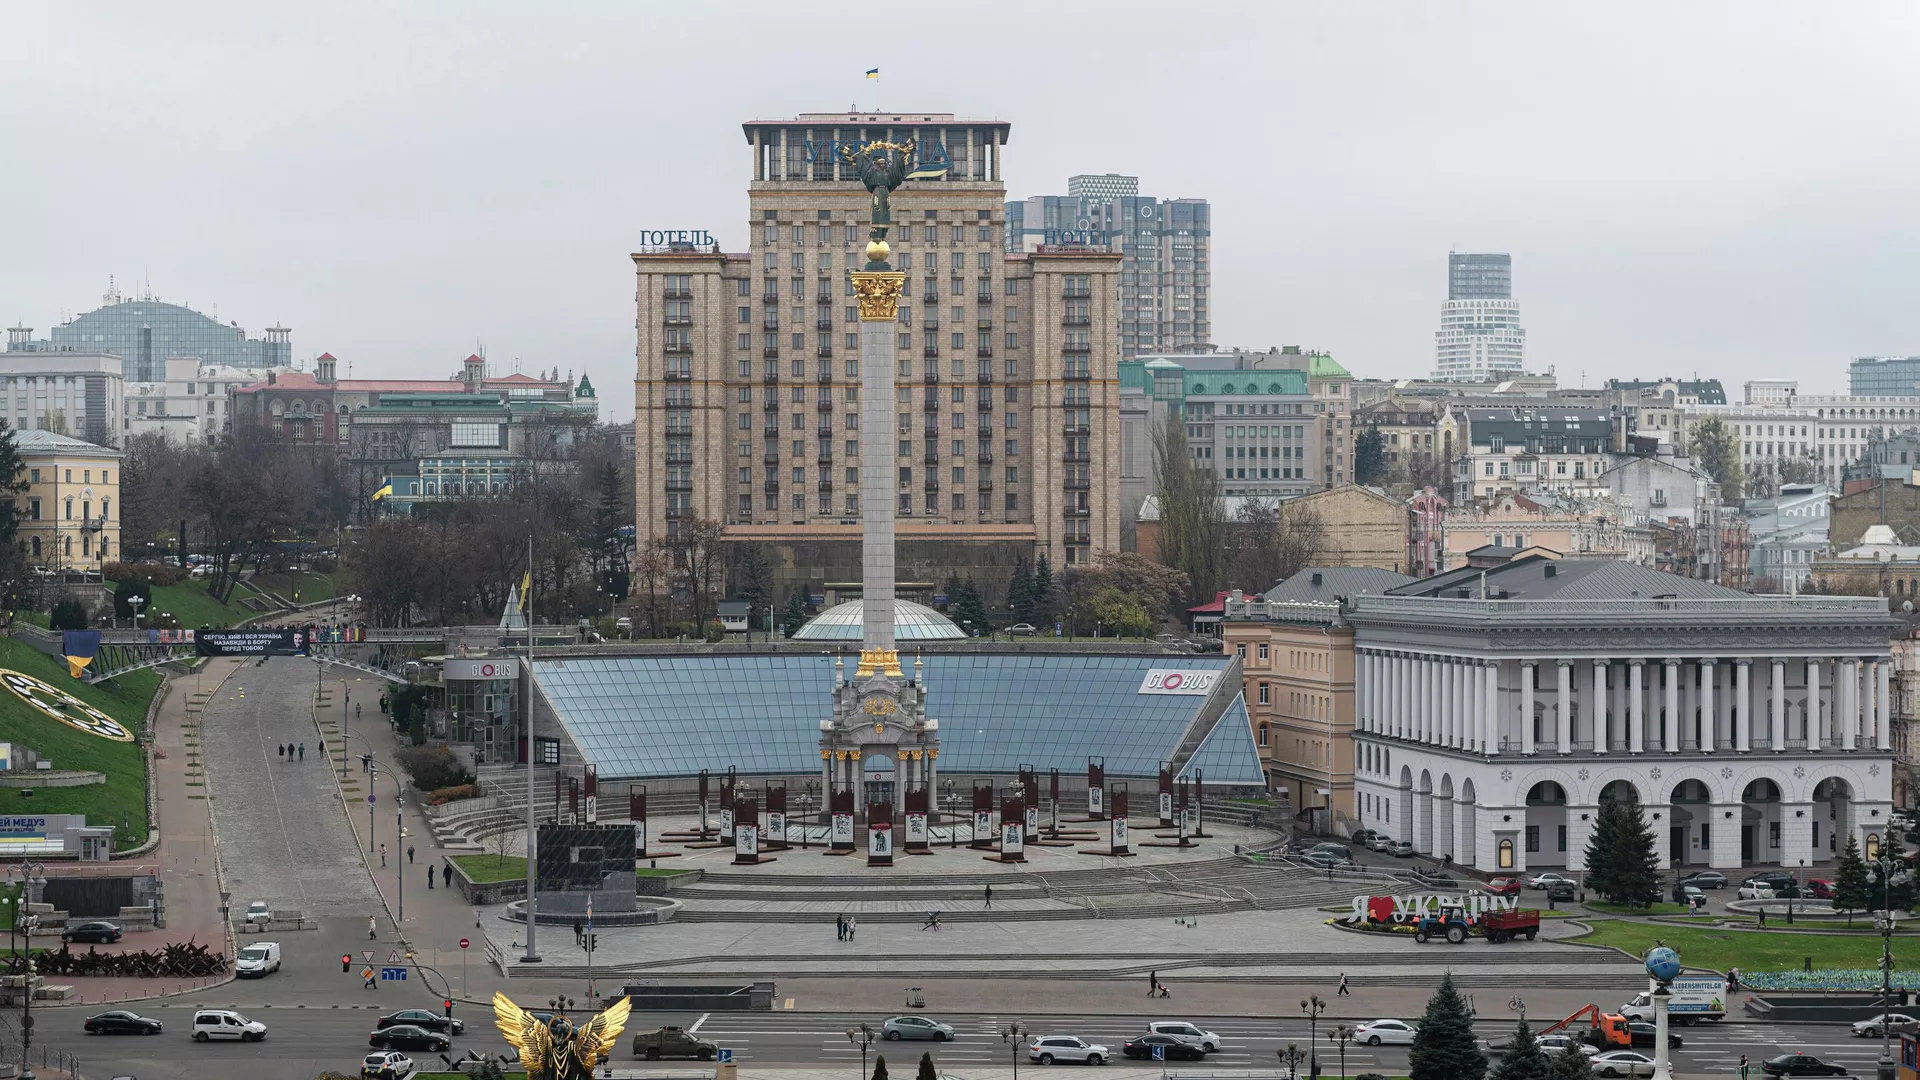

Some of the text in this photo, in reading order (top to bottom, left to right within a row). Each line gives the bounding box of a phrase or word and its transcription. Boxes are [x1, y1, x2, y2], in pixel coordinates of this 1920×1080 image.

[640, 230, 714, 245] ГОТЕЛЬ
[1044, 230, 1112, 245] HOTEL
[471, 664, 511, 676] GLOBUS
[1147, 673, 1213, 690] GLOBUS
[13, 818, 45, 828] МЕДУЗ
[1347, 895, 1370, 923] Я
